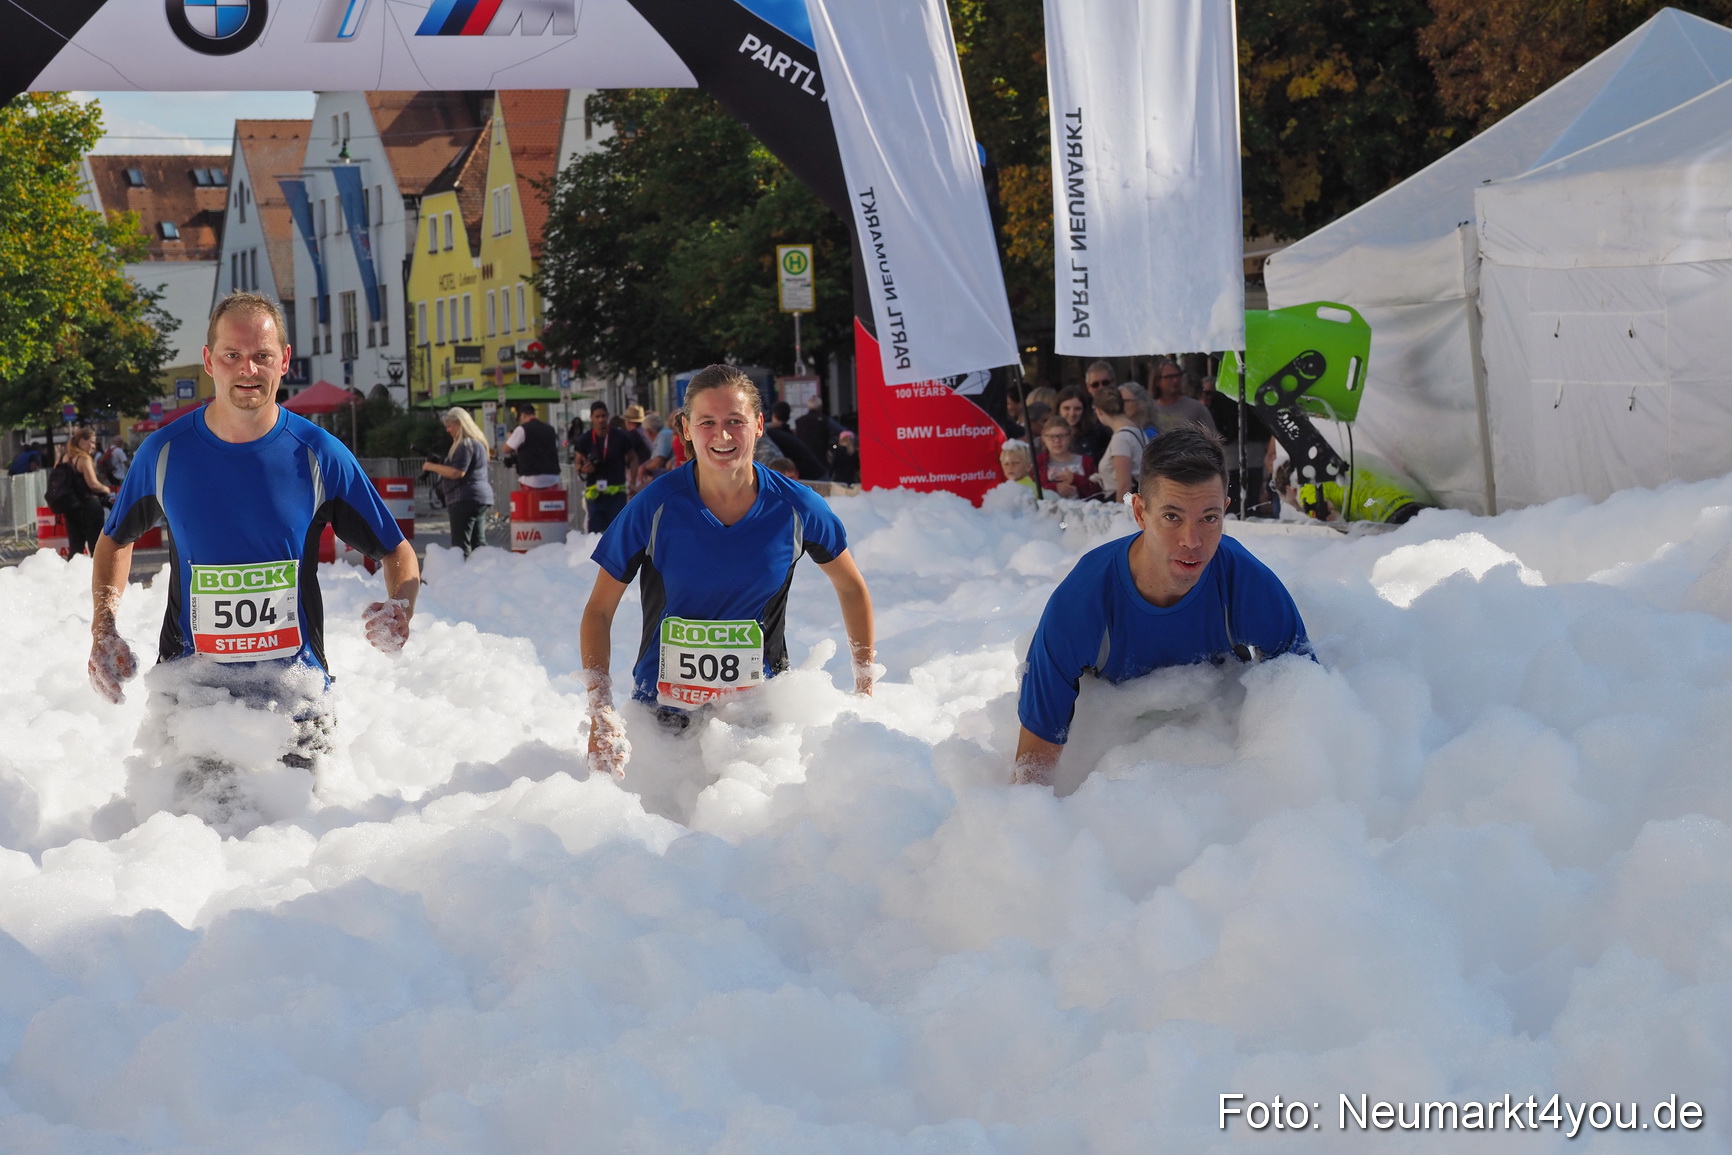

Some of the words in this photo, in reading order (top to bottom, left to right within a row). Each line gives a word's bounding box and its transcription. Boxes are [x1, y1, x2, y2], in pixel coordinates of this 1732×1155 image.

[738, 33, 817, 96] PARTL
[932, 376, 958, 387] NEXT
[895, 389, 911, 399] 100
[913, 387, 947, 398] YEARS
[897, 426, 933, 439] BMW
[899, 469, 997, 484] www.bmw-partl.de
[515, 528, 542, 541] AVIA
[198, 565, 288, 590] BOCK
[214, 598, 277, 629] 504
[670, 622, 752, 644] BOCK
[215, 635, 279, 651] STEFAN
[679, 653, 740, 682] 508
